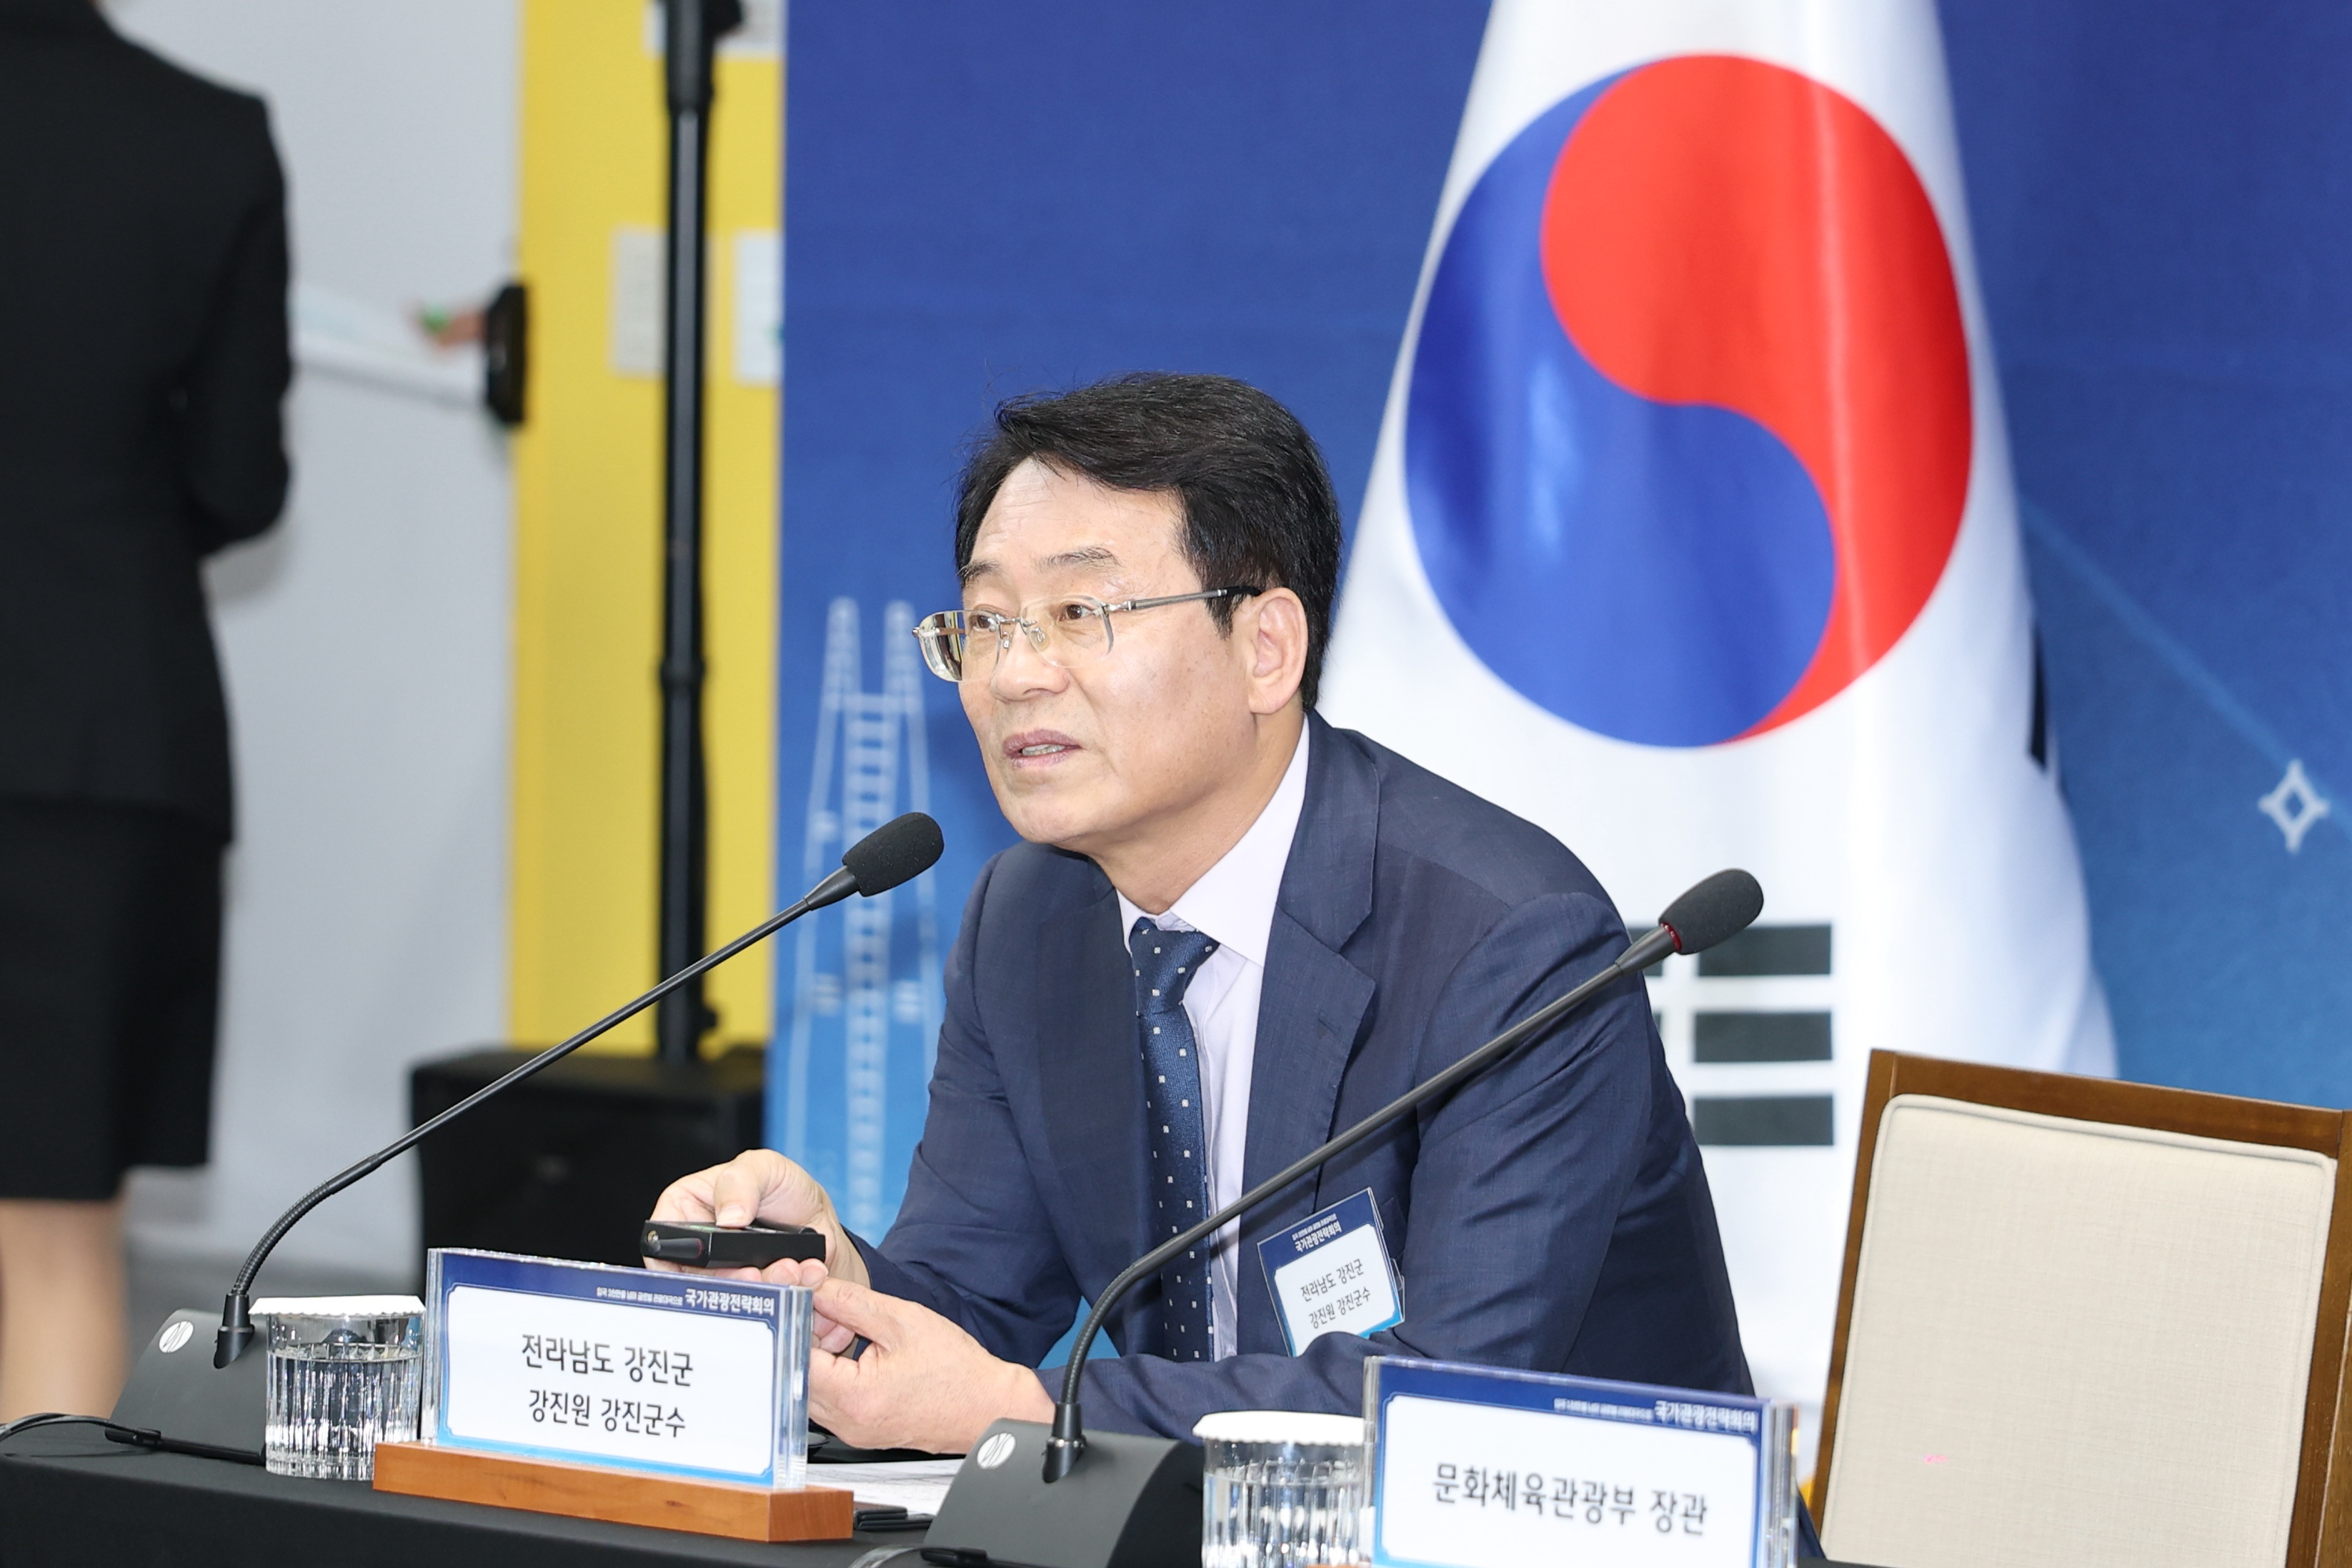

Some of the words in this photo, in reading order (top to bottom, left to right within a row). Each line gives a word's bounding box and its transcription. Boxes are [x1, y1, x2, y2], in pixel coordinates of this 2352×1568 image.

[1295, 1220, 1342, 1252] 국가관광전략회의
[1300, 1273, 1337, 1302] 전라남도
[1336, 1259, 1364, 1284] 강진군
[685, 1288, 774, 1316] 국가관광전략회의
[1308, 1303, 1336, 1329] 강진원
[1337, 1287, 1371, 1315] 강진군수
[522, 1334, 614, 1374] 전라남도
[624, 1347, 694, 1387] 강진군
[529, 1389, 590, 1427] 강진원
[601, 1398, 686, 1438] 강진군수
[1654, 1399, 1757, 1434] 국가관광전략회의
[1433, 1462, 1637, 1527] 문화체육관광부
[1650, 1490, 1709, 1536] 장관
